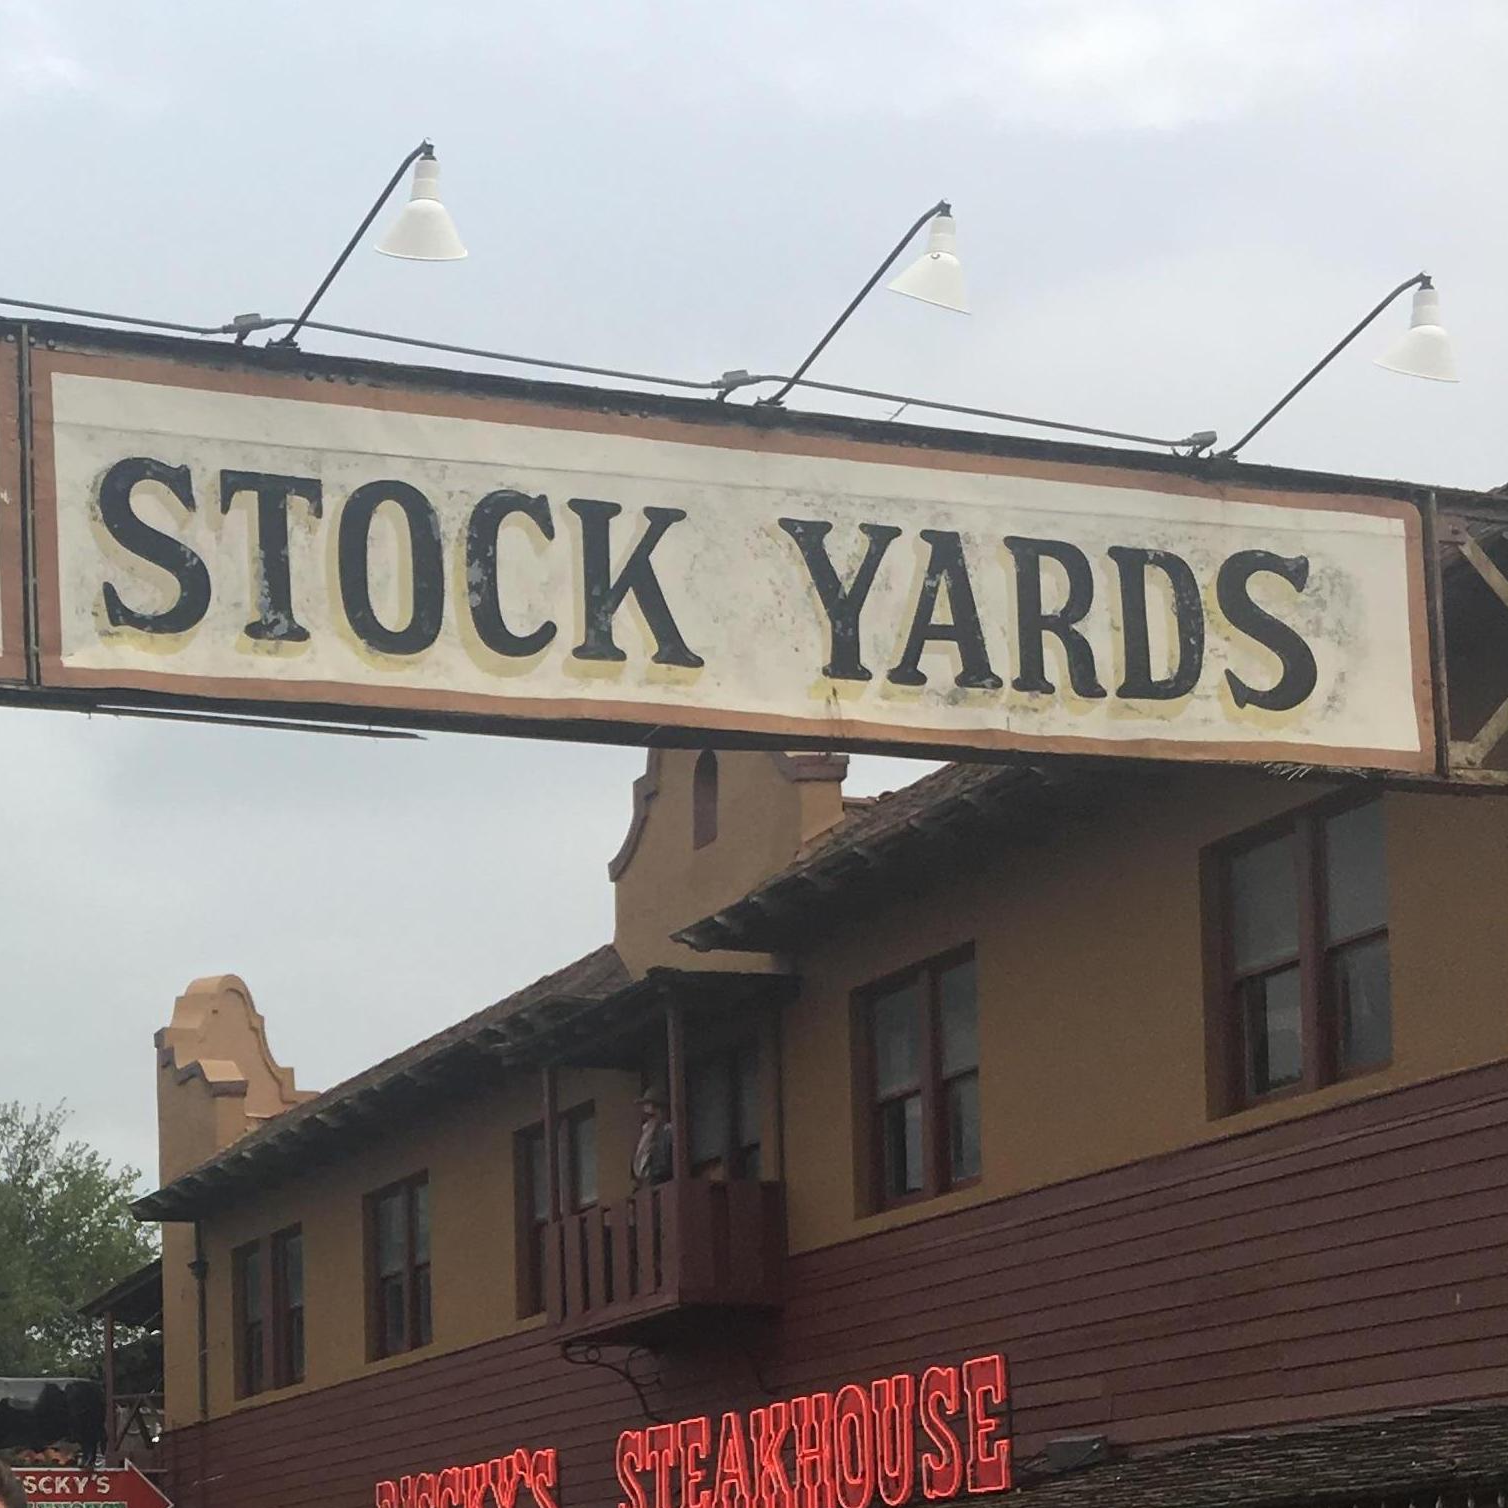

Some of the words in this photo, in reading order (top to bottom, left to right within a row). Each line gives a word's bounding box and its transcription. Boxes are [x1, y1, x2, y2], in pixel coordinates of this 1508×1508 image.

[99, 457, 704, 668] STOCK
[778, 518, 1318, 710] YARDS
[22, 1475, 111, 1494] SCKY'S
